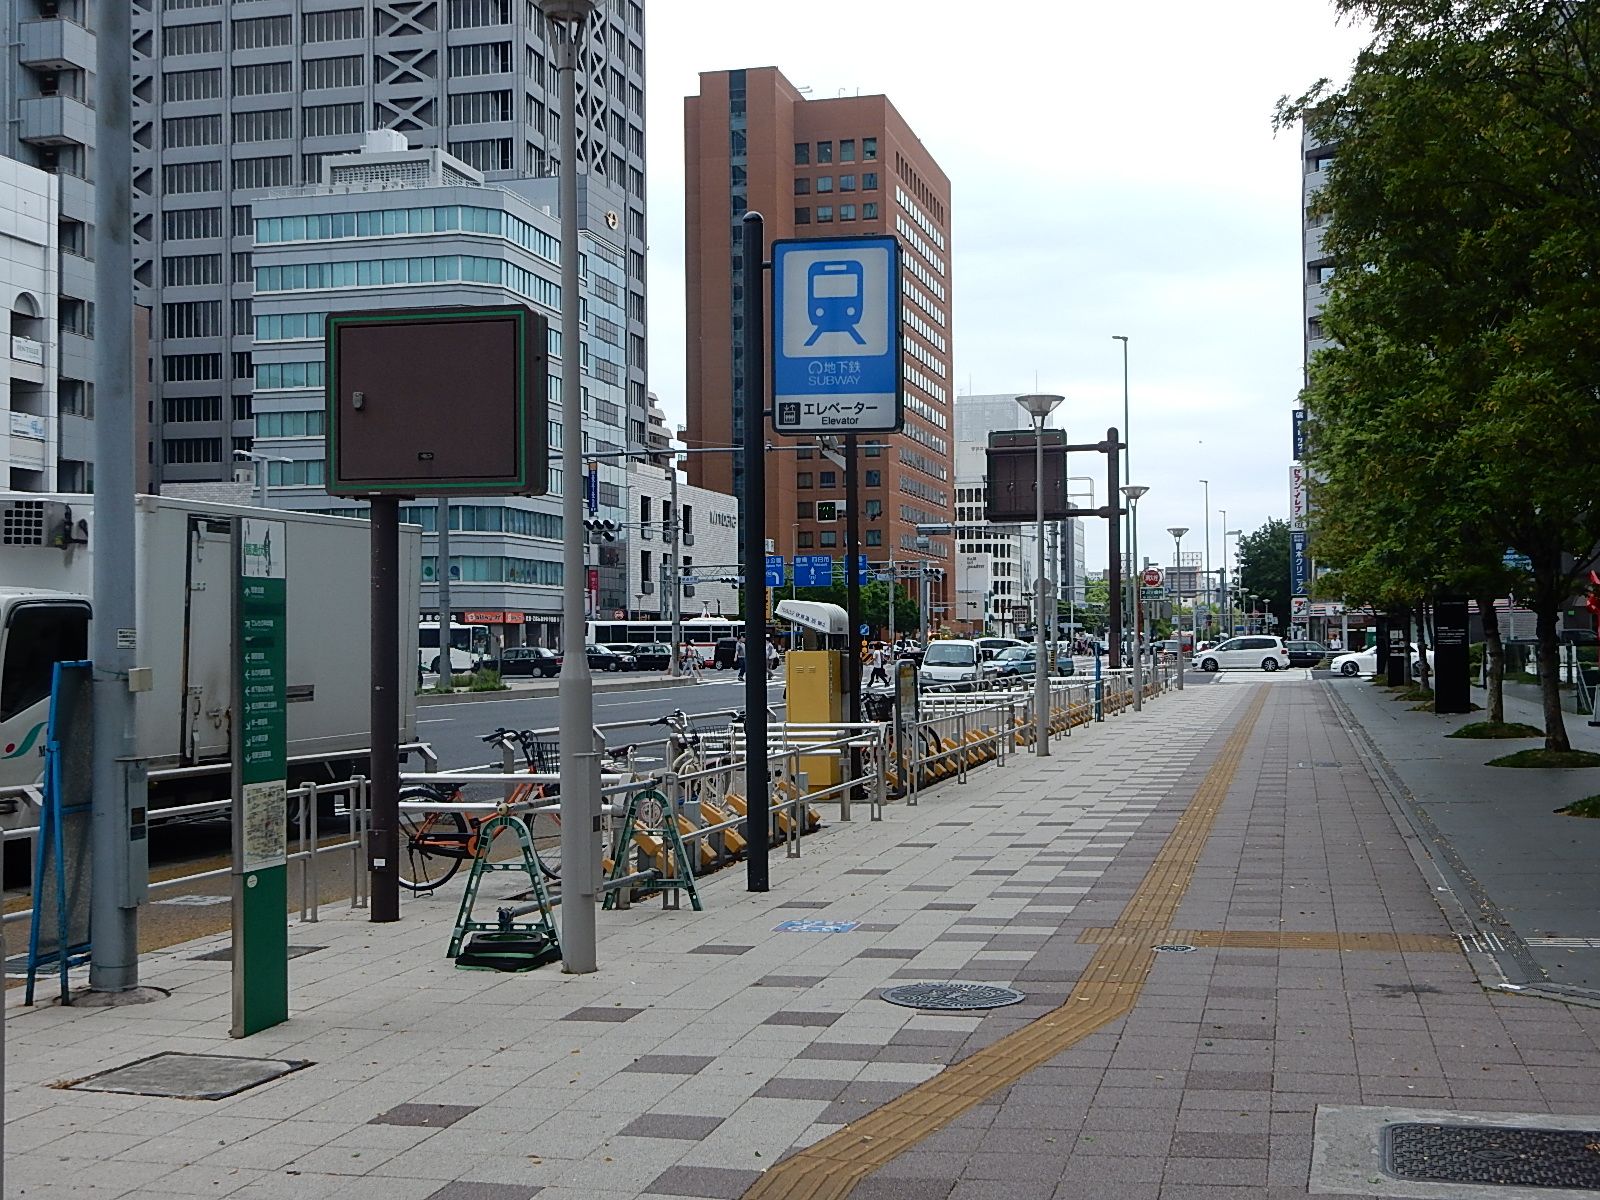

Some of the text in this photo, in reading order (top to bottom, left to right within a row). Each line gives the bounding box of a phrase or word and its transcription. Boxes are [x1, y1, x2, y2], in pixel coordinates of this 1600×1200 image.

[824, 360, 861, 374] 地下鉄
[808, 375, 861, 386] SUBWAY
[803, 401, 878, 415] エレベーター
[821, 416, 859, 425] Elevator
[1295, 543, 1304, 594] 青木クリニック
